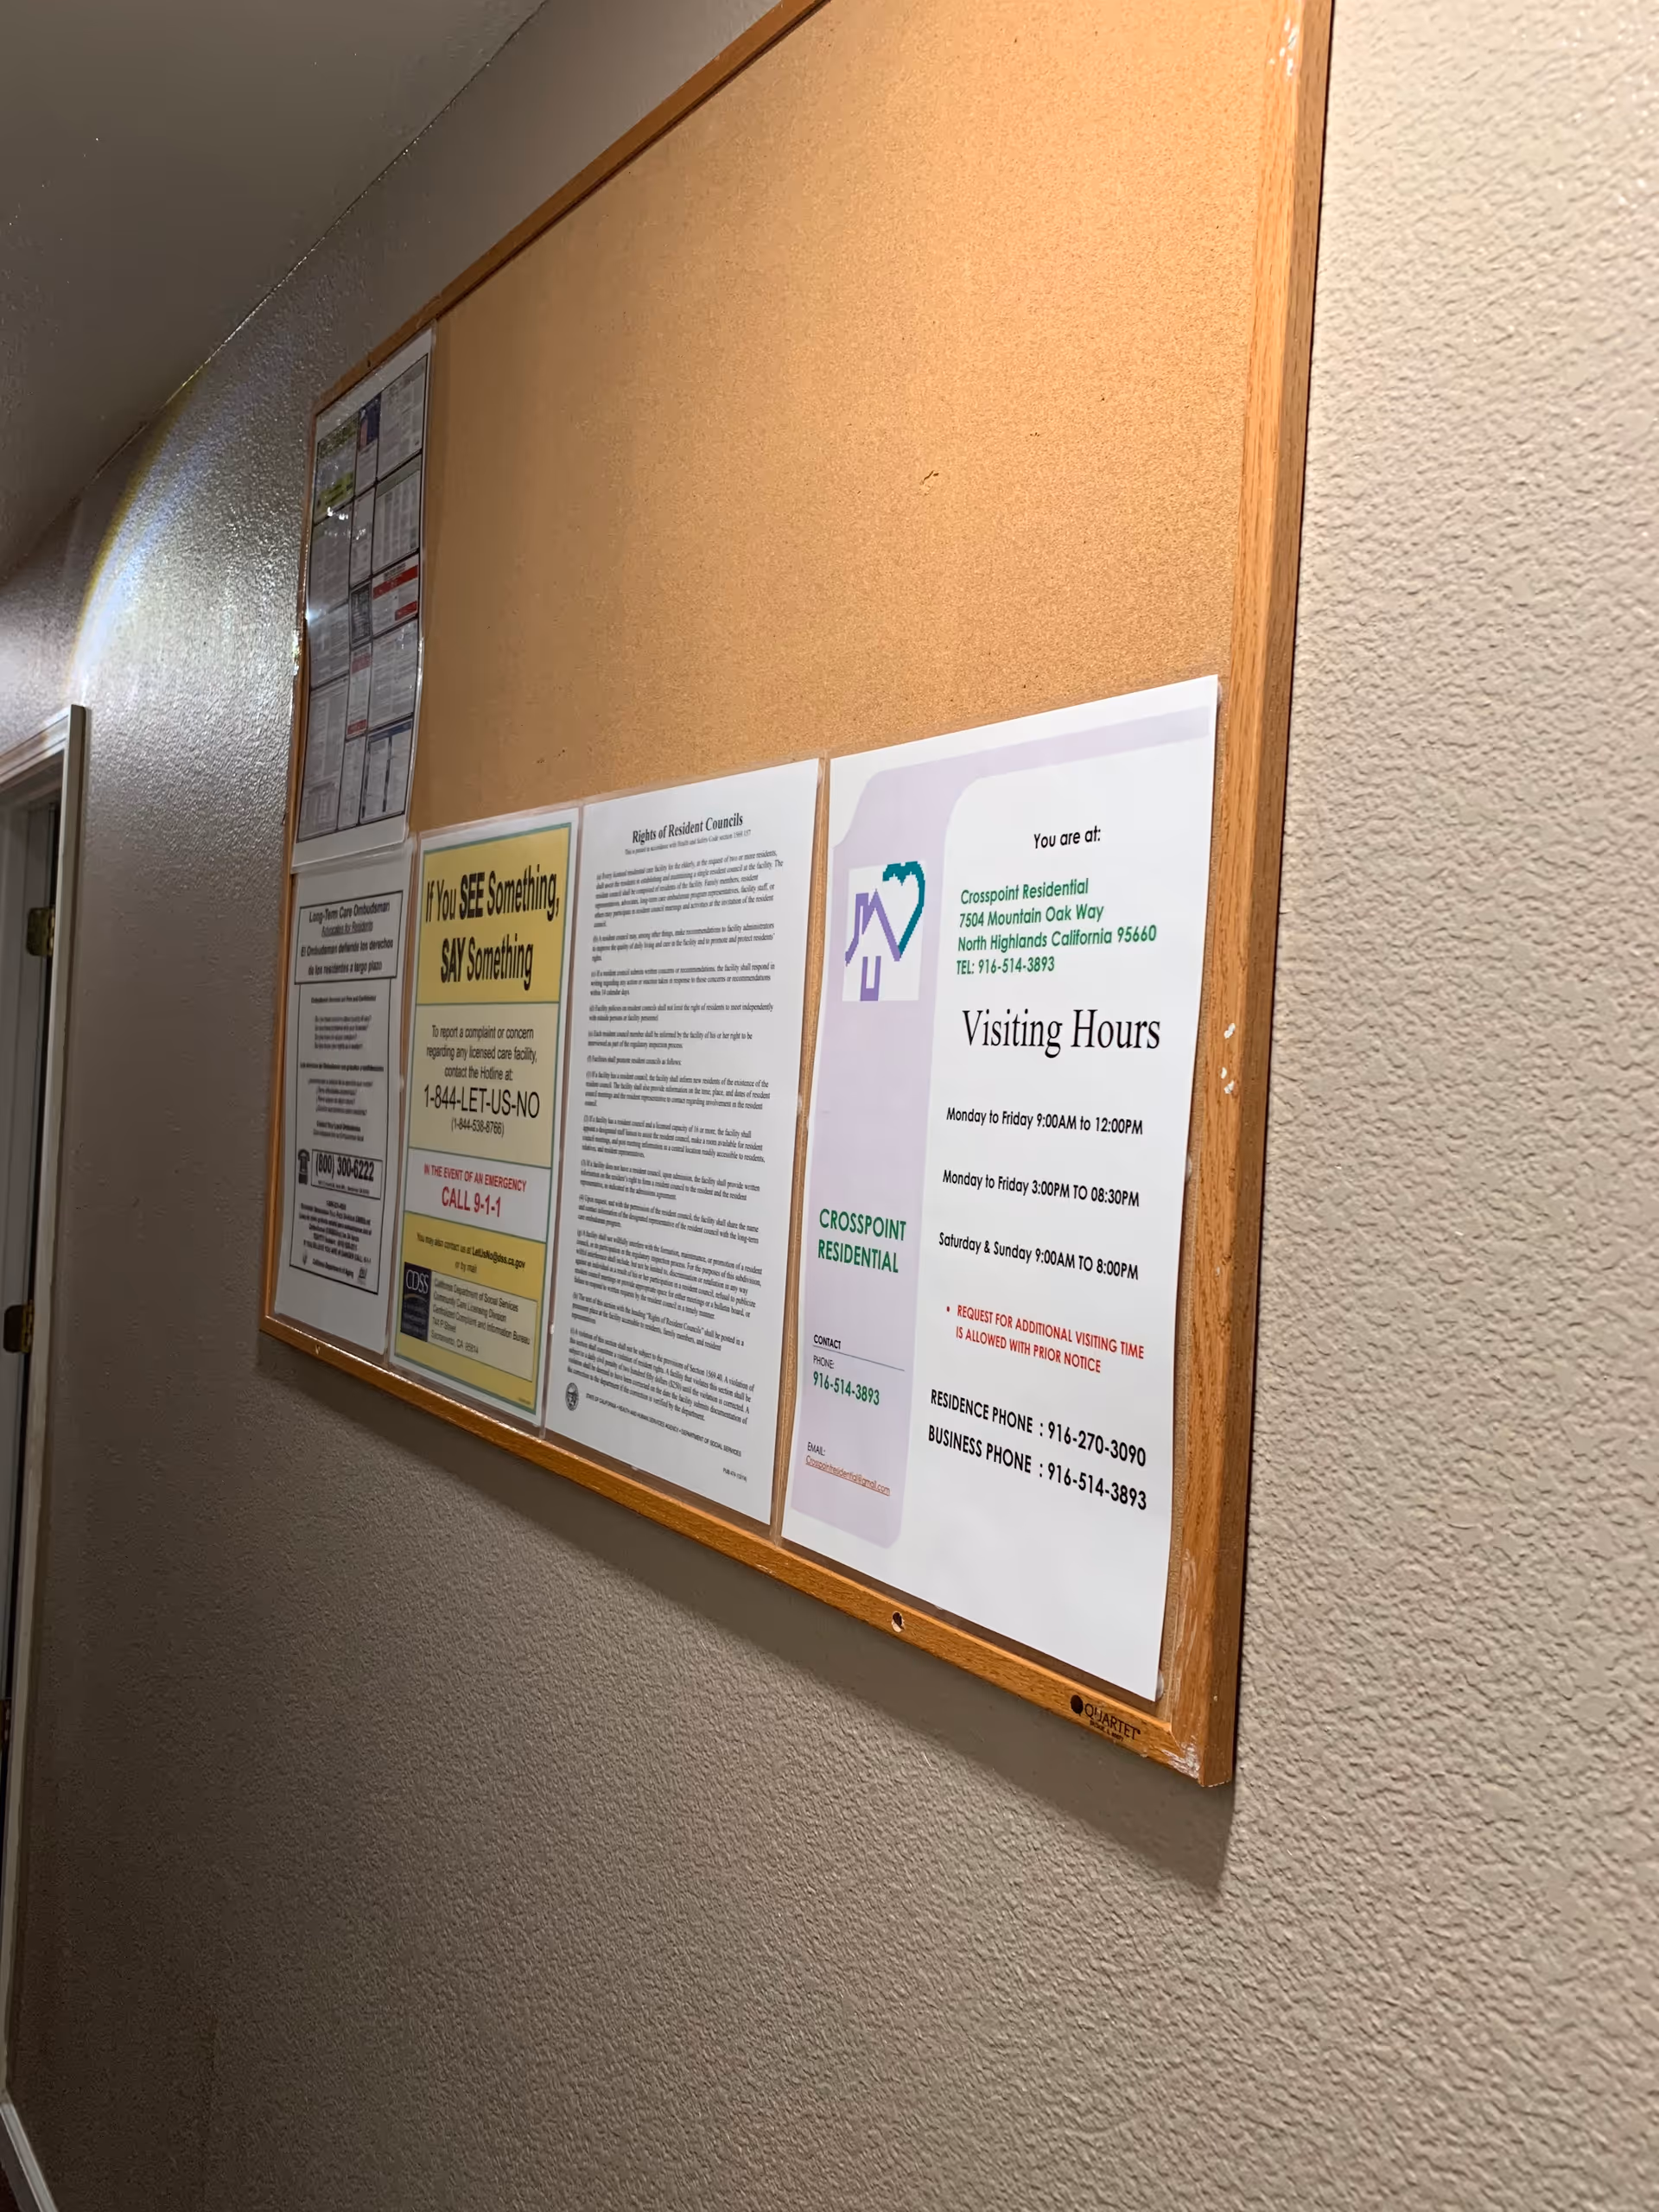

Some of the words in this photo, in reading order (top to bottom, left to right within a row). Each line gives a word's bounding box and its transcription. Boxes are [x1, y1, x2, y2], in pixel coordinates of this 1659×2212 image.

[632, 829, 656, 845] Rights
[658, 826, 666, 839] of
[668, 821, 703, 837] Resident
[705, 813, 743, 831] Councils
[1034, 834, 1056, 849] You
[1060, 832, 1080, 845] are
[1085, 826, 1101, 842] at:
[426, 880, 435, 923] If
[436, 880, 456, 921] You
[460, 872, 485, 919] SEE
[487, 864, 559, 921] Something,
[961, 885, 1019, 906] Crosspoint
[1023, 878, 1089, 899] Residential
[960, 912, 983, 927] 7504
[988, 907, 1041, 926] Mountain
[1046, 906, 1071, 922] Oak
[1077, 904, 1103, 922] Way
[958, 936, 987, 950] North
[990, 931, 1047, 952] Highlands
[1052, 928, 1112, 946] California
[1118, 925, 1156, 942] 95660
[441, 937, 467, 982] SAY
[467, 933, 533, 990] Something
[957, 960, 975, 975] TEL:
[979, 957, 1054, 973] 916-514-3893
[432, 1025, 439, 1039] To
[440, 1027, 458, 1040] report
[460, 1029, 463, 1038] a
[465, 1025, 496, 1041] complaint
[498, 1030, 505, 1039] or
[506, 1029, 534, 1039] concern
[962, 1008, 1062, 1058] Visiting
[1071, 1009, 1161, 1050] Hours
[427, 1046, 454, 1060] regarding
[456, 1050, 467, 1060] any
[469, 1046, 496, 1059] licensed
[498, 1049, 512, 1060] care
[514, 1046, 537, 1063] facility,
[444, 1065, 467, 1078] contact
[468, 1065, 479, 1078] the
[480, 1065, 503, 1080] Hotline
[505, 1069, 513, 1081] at:
[424, 1084, 540, 1118] 1-844-LET-US-NO
[947, 1108, 986, 1126] Monday
[989, 1110, 999, 1123] to
[1002, 1111, 1033, 1129] Friday
[1037, 1113, 1076, 1129] 9:00AM
[1080, 1116, 1090, 1130] to
[1096, 1117, 1142, 1135] 12:00PM
[315, 1153, 334, 1179] (800)
[337, 1155, 374, 1182] 300-6222
[424, 1164, 429, 1175] IN
[431, 1165, 442, 1177] THE
[444, 1167, 463, 1180] EVENT
[465, 1171, 474, 1182] OF
[474, 1173, 483, 1184] AN
[485, 1174, 526, 1192] EMERGENCY
[442, 1186, 470, 1211] CALL
[474, 1192, 501, 1217] 9-1-1
[943, 1170, 982, 1190] Monday
[986, 1174, 995, 1188] to
[998, 1176, 1028, 1196] Friday
[1032, 1180, 1070, 1198] 3:00PM
[1073, 1185, 1087, 1199] TO
[1091, 1187, 1139, 1206] 08:30PM
[820, 1209, 906, 1241] CROSSPOINT
[818, 1239, 898, 1273] RESIDENTIAL
[939, 1232, 982, 1255] Saturday
[984, 1241, 990, 1253] &
[994, 1241, 1032, 1263] Sunday
[1035, 1249, 1075, 1268] 9:00AM
[1078, 1255, 1093, 1271] TO
[1096, 1259, 1138, 1280] 8:00PM
[406, 1269, 429, 1294] CDSS
[814, 1334, 841, 1349] CONTACT
[957, 1305, 993, 1324] REQUEST
[995, 1313, 1013, 1328] FOR
[1015, 1319, 1072, 1342] ADDITIONAL
[1076, 1332, 1117, 1352] VISITING
[1121, 1341, 1144, 1359] TIME
[814, 1355, 834, 1369] PHONE:
[957, 1326, 963, 1338] IS
[965, 1329, 1007, 1349] ALLOWED
[1009, 1339, 1030, 1355] WITH
[1033, 1344, 1061, 1363] PRIOR
[1065, 1352, 1101, 1373] NOTICE
[814, 1371, 879, 1405] 916-514-3893
[931, 1389, 988, 1420] RESIDENCE
[993, 1407, 1033, 1433] PHONE
[1049, 1421, 1146, 1466] 916-270-3090
[808, 1442, 824, 1456] EMAIL:
[929, 1425, 982, 1457] BUSINESS
[987, 1443, 1031, 1473] PHONE
[1048, 1463, 1146, 1510] 916-514-3893
[1084, 1703, 1139, 1739] QUARTET
